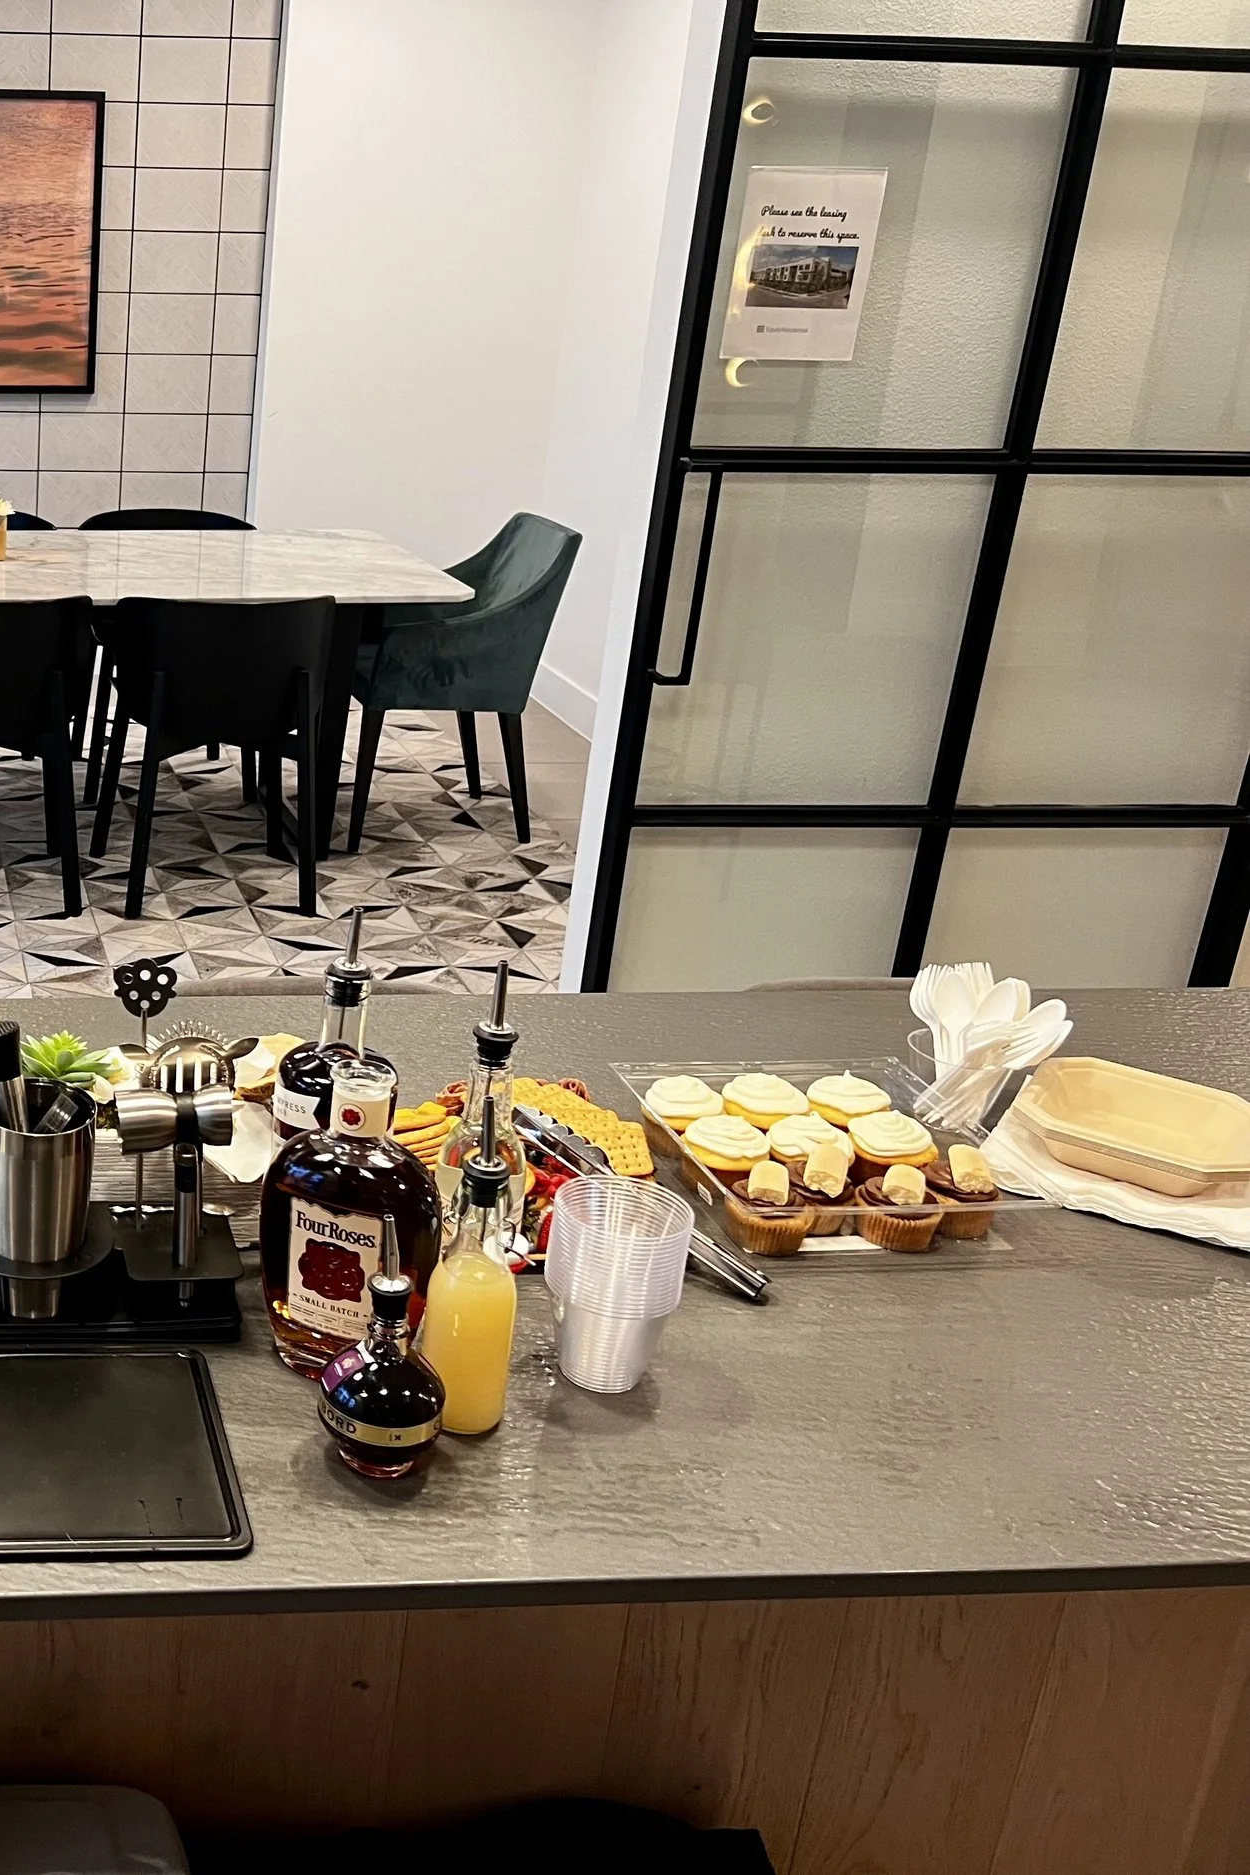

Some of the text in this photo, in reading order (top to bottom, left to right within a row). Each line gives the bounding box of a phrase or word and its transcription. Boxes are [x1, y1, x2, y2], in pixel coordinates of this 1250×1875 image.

[760, 205, 848, 223] Please see the leasing
[777, 227, 786, 238] to
[788, 230, 818, 238] reserve
[820, 228, 834, 239] this
[836, 230, 860, 244] space.
[296, 1210, 376, 1248] Four Roses
[299, 1294, 359, 1318] SMALL BATCH
